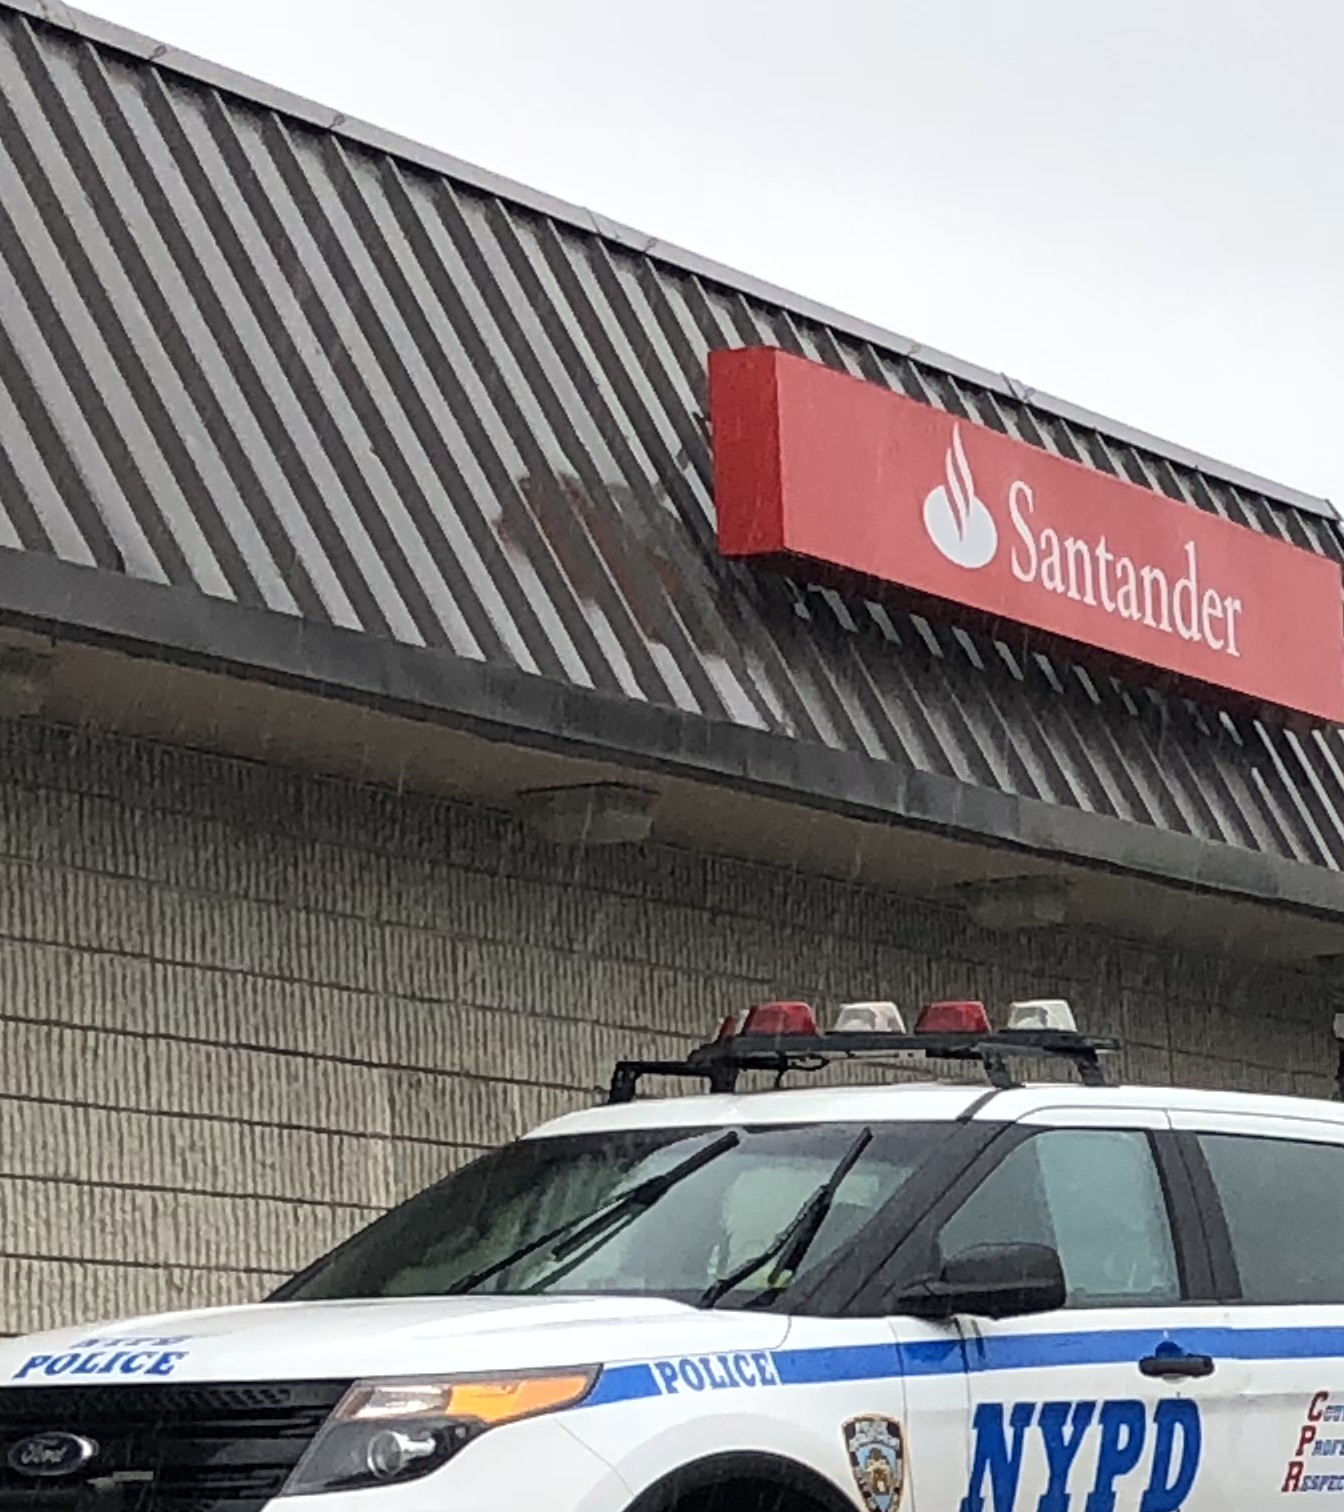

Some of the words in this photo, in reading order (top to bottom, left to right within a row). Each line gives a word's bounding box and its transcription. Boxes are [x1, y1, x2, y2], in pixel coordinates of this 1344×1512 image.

[1008, 480, 1242, 657] Santander
[11, 1350, 190, 1381] POLICE
[653, 1351, 777, 1396] POLICE
